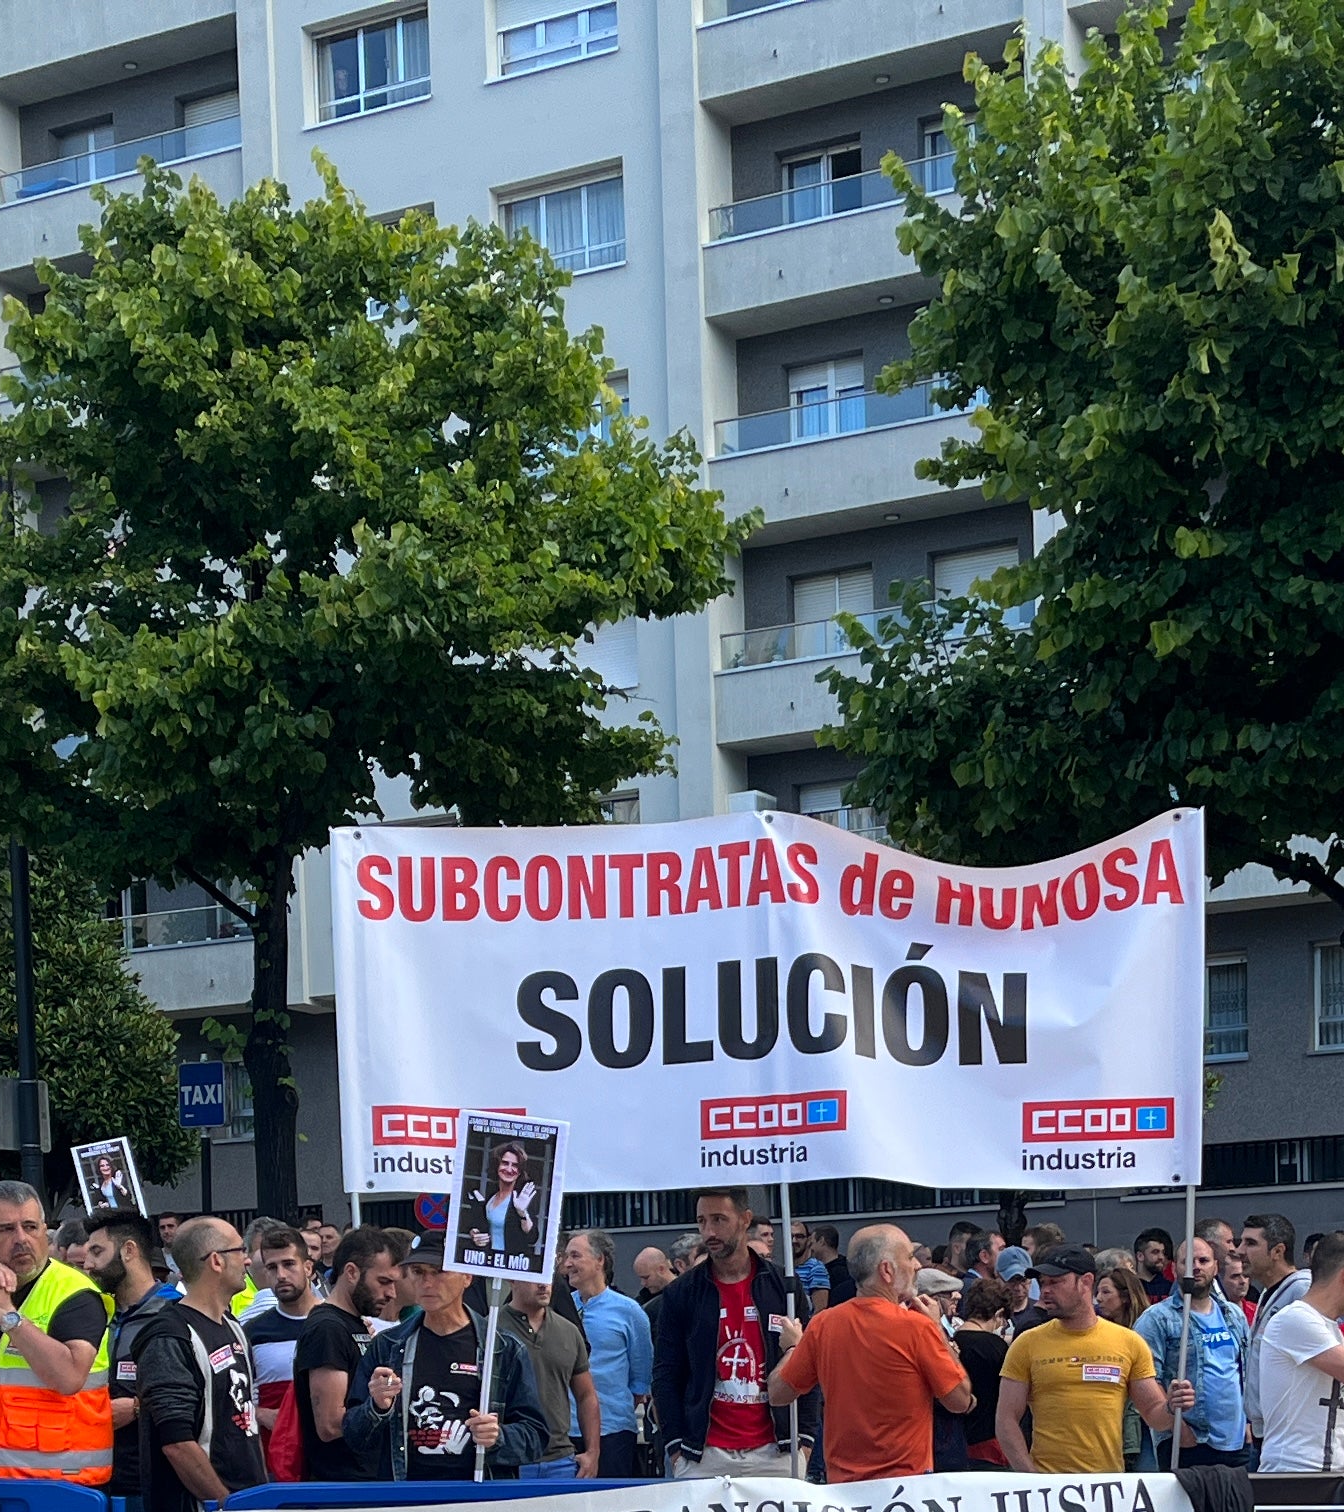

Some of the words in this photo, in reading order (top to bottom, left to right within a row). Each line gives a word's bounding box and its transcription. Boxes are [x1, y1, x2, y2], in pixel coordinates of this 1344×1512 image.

[357, 837, 819, 923] SUBCONTRATAS
[840, 851, 915, 920] de
[935, 838, 1185, 932] HUNOSA
[515, 942, 1030, 1072] SOLUCIÓN
[180, 1083, 222, 1106] TAXI
[381, 1113, 454, 1140] CCO
[708, 1101, 803, 1132] CCOO
[1031, 1107, 1131, 1135] CCOO
[372, 1151, 454, 1174] indust
[700, 1141, 808, 1169] industria
[1022, 1146, 1136, 1171] industria
[464, 1249, 485, 1265] UNO
[494, 1253, 506, 1268] EL
